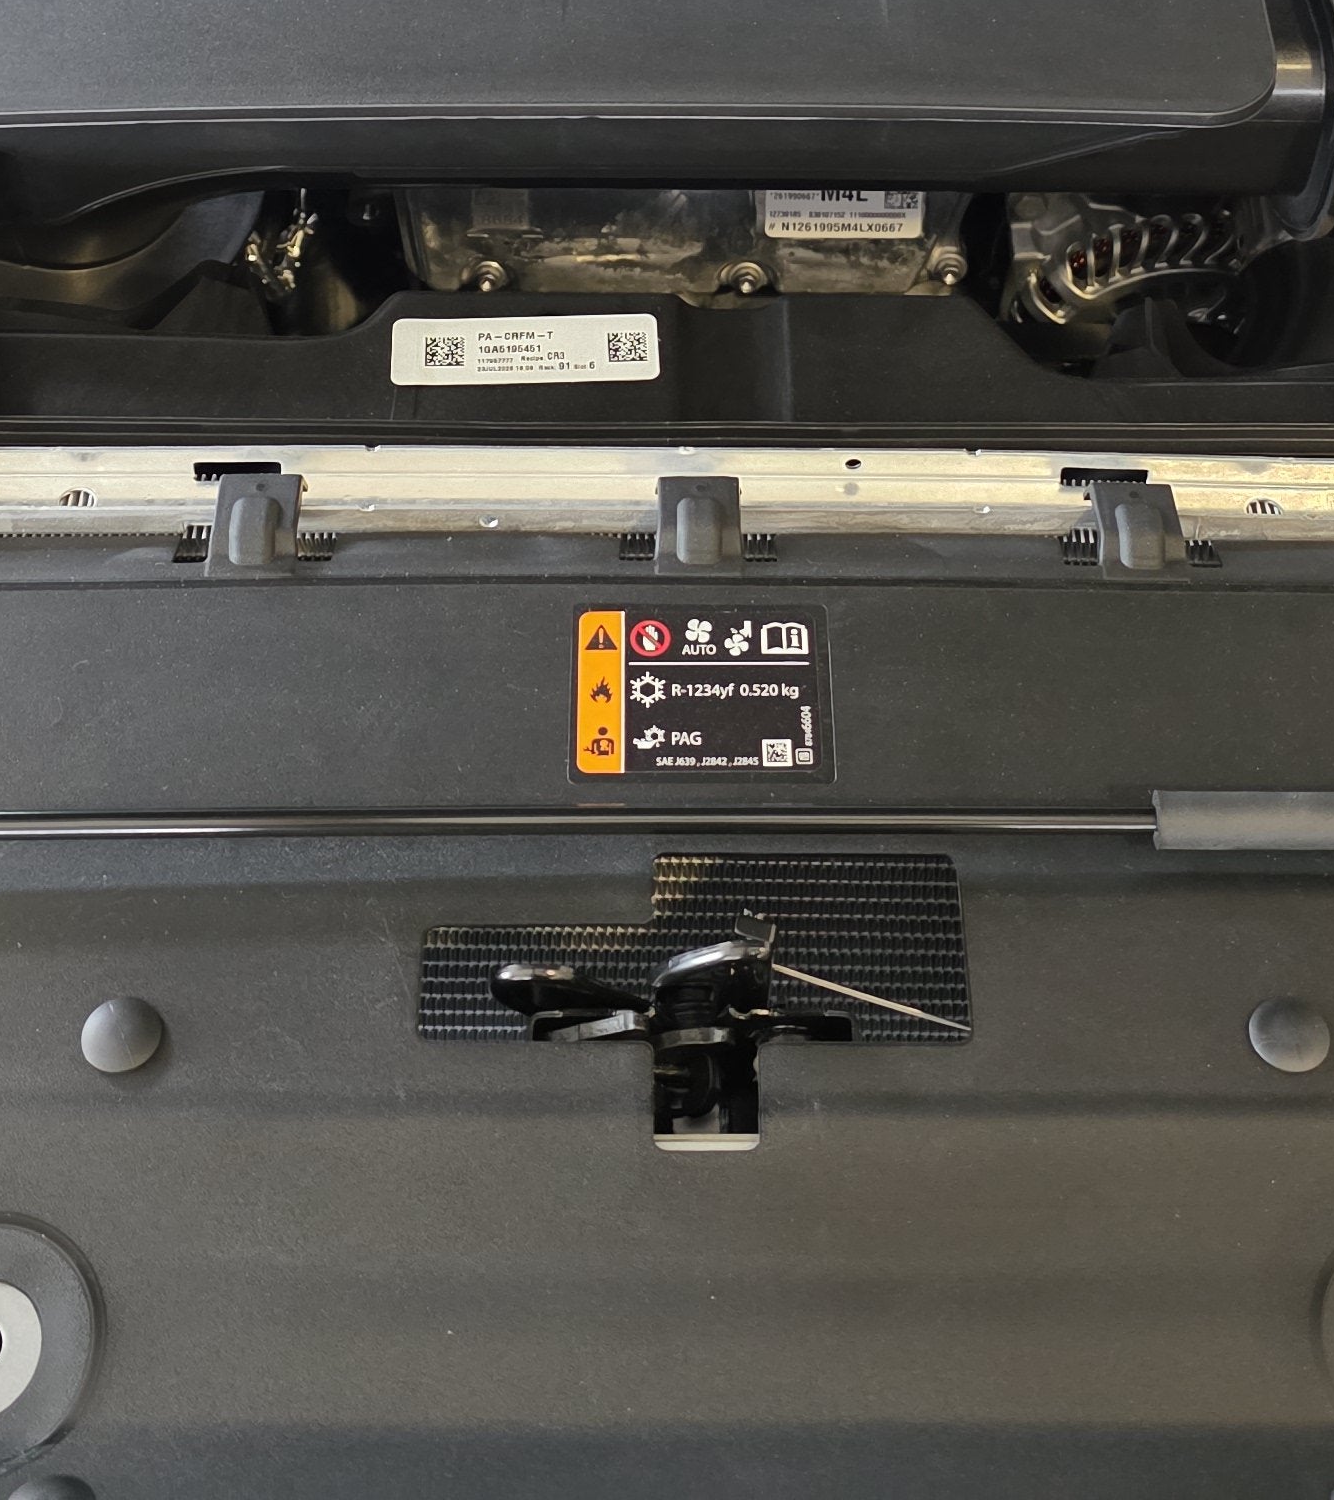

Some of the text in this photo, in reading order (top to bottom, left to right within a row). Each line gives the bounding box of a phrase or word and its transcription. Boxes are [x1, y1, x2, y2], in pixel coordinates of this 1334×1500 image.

[547, 352, 565, 361] CR3
[558, 361, 571, 371] 91
[588, 361, 596, 370] 6
[681, 644, 717, 656] AUTO
[671, 682, 800, 700] R-1234yf 0.520 kg
[671, 731, 703, 747] PAG
[655, 756, 675, 767] SAE
